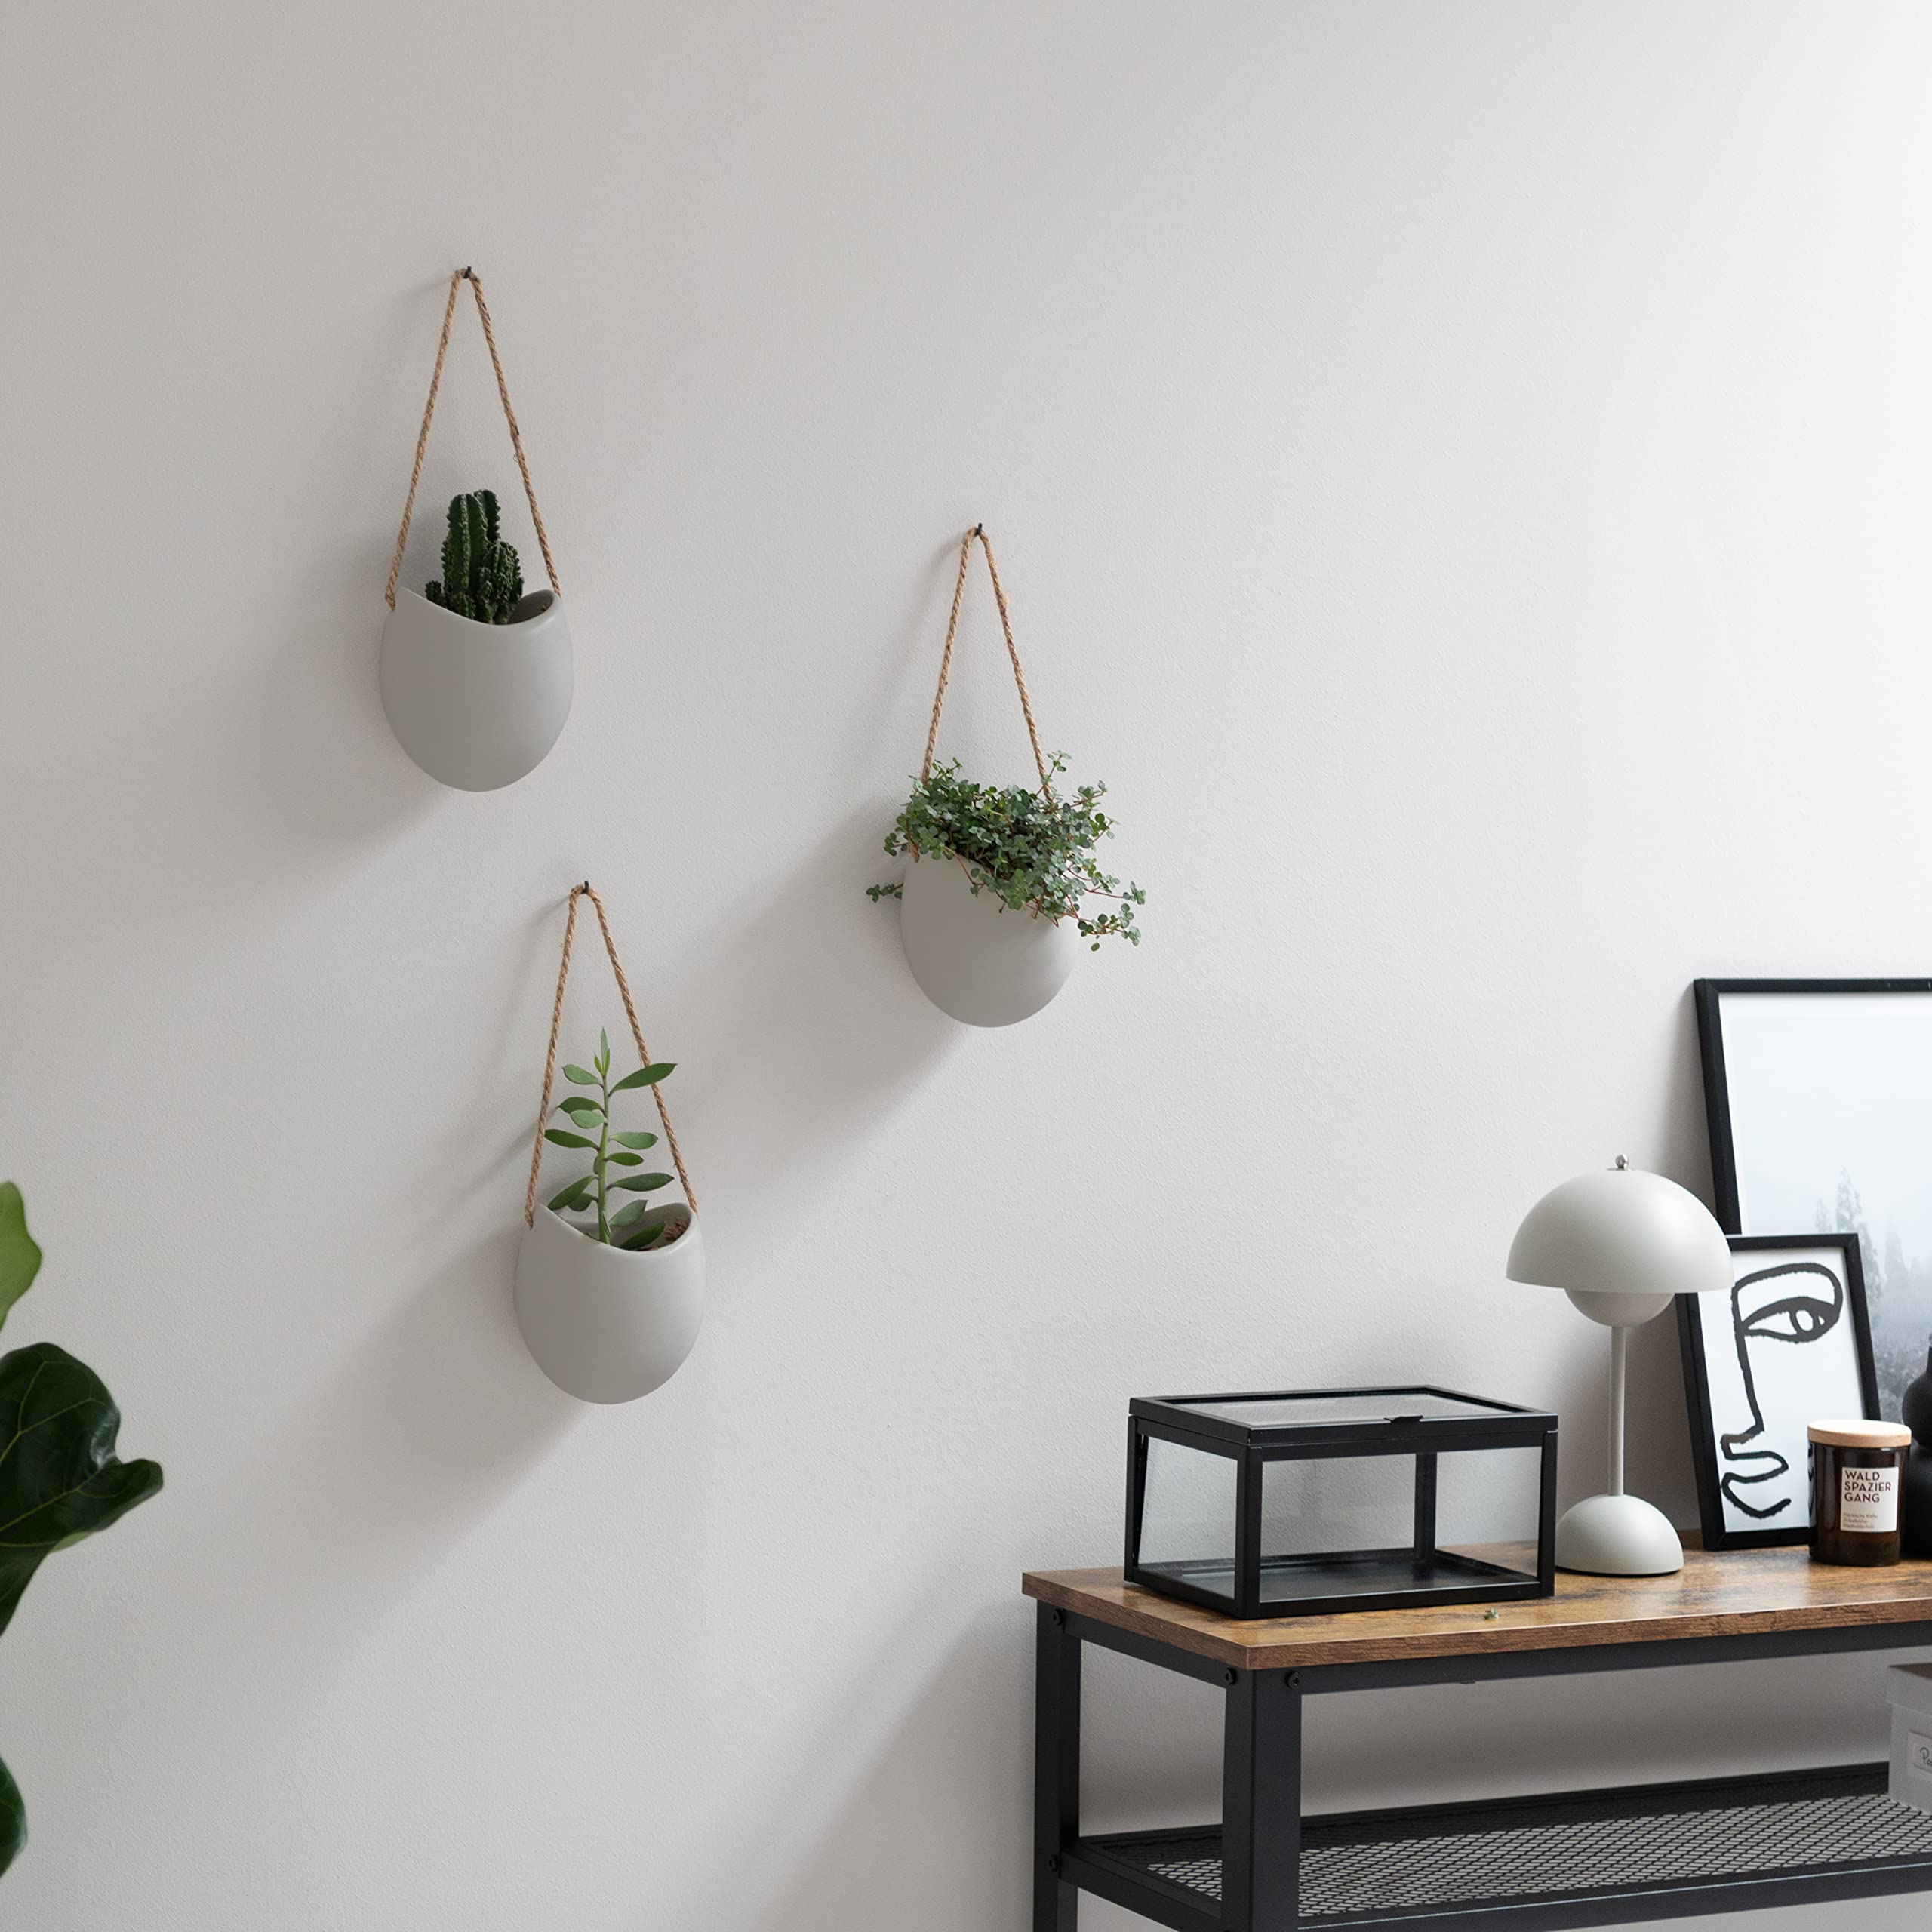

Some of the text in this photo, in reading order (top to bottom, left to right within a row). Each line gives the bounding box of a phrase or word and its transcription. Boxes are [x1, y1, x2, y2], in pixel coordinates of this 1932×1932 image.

[1845, 1470, 1880, 1481] WALD
[1844, 1481, 1891, 1492] SPAZIER
[1844, 1492, 1880, 1503] GANG
